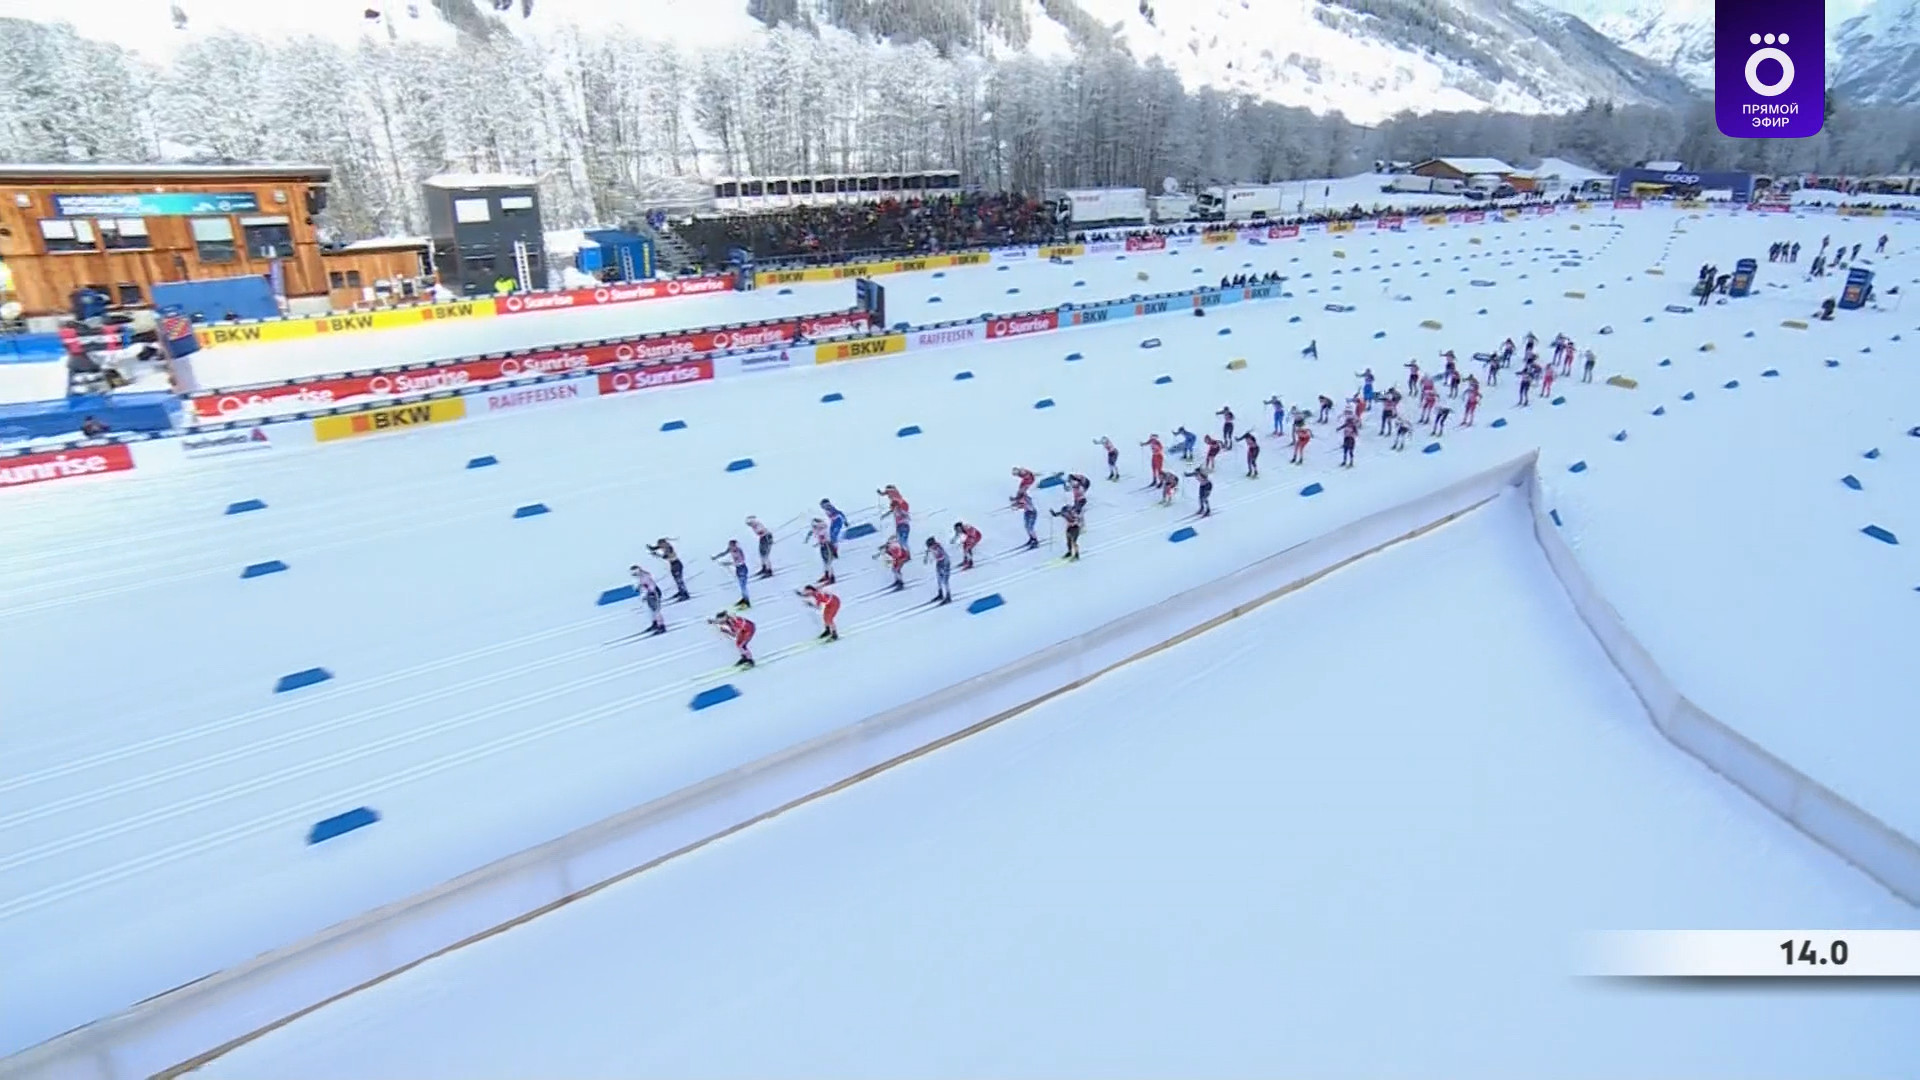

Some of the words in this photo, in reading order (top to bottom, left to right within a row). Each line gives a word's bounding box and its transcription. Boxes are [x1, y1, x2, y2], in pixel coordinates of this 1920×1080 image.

[609, 286, 656, 301] Sunrise
[682, 279, 724, 293] Sunrise
[523, 293, 574, 309] Sunrise
[1144, 301, 1167, 313] BKW
[435, 303, 473, 319] BKW
[1082, 310, 1108, 323] BKW
[331, 315, 373, 332] BKW
[1008, 319, 1049, 333] Sunrise
[215, 326, 261, 344] BKW
[732, 327, 783, 346] Sunrise
[636, 339, 694, 358] Sunrise
[851, 340, 886, 356] BKW
[523, 352, 589, 371] Sunrise
[395, 368, 469, 393] Sunrise
[635, 365, 700, 387] Sunrise
[488, 384, 578, 411] RAIFFEISEN
[374, 405, 432, 430] BKW
[0, 455, 108, 484] unrise
